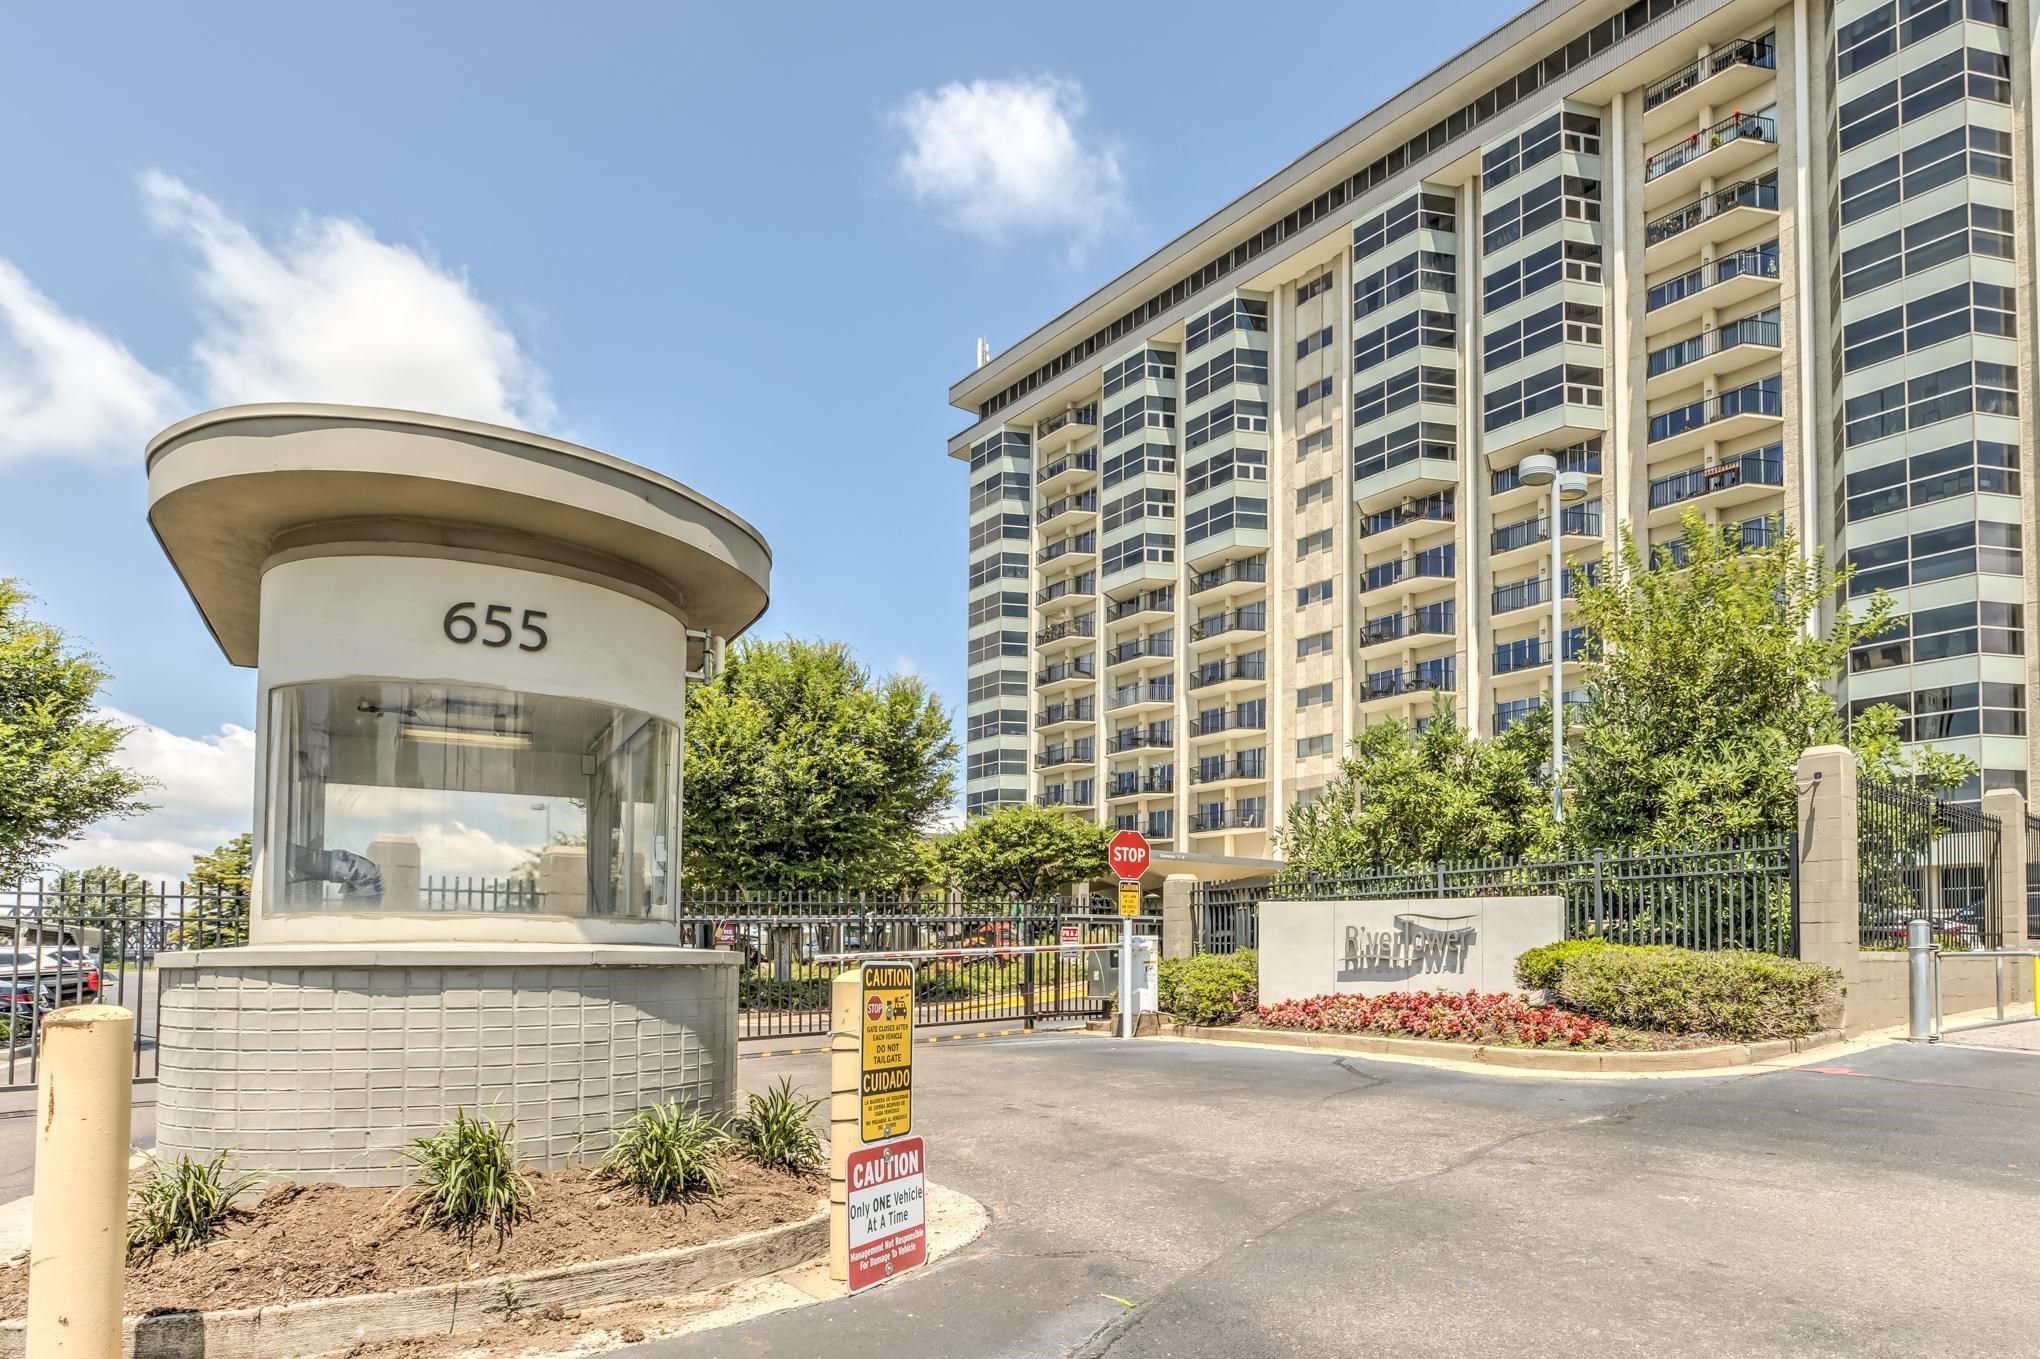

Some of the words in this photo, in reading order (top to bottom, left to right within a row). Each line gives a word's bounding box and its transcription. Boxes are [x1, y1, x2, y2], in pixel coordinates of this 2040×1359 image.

[443, 601, 548, 652] 655
[1113, 846, 1146, 863] STOP
[865, 968, 911, 987] CAUTION
[867, 1003, 882, 1014] STOP
[886, 1032, 903, 1040] VEHICLE
[874, 1054, 902, 1064] TAILGATE
[876, 1044, 886, 1054] DO
[888, 1043, 899, 1052] NOT
[863, 1069, 910, 1093] CUIDADO
[853, 1149, 919, 1189] CAUTION
[850, 1202, 870, 1220] Only
[873, 1194, 892, 1212] ONE
[894, 1186, 922, 1206] Vehicle
[867, 1217, 877, 1234] At
[880, 1214, 886, 1229] A
[889, 1210, 908, 1226] Time
[850, 1243, 884, 1263] Management
[884, 1238, 894, 1250] Not
[895, 1228, 924, 1246] Responsible
[860, 1260, 869, 1271] For
[870, 1253, 891, 1268] Damage
[891, 1249, 898, 1258] To
[898, 1242, 916, 1255] Vehicle
